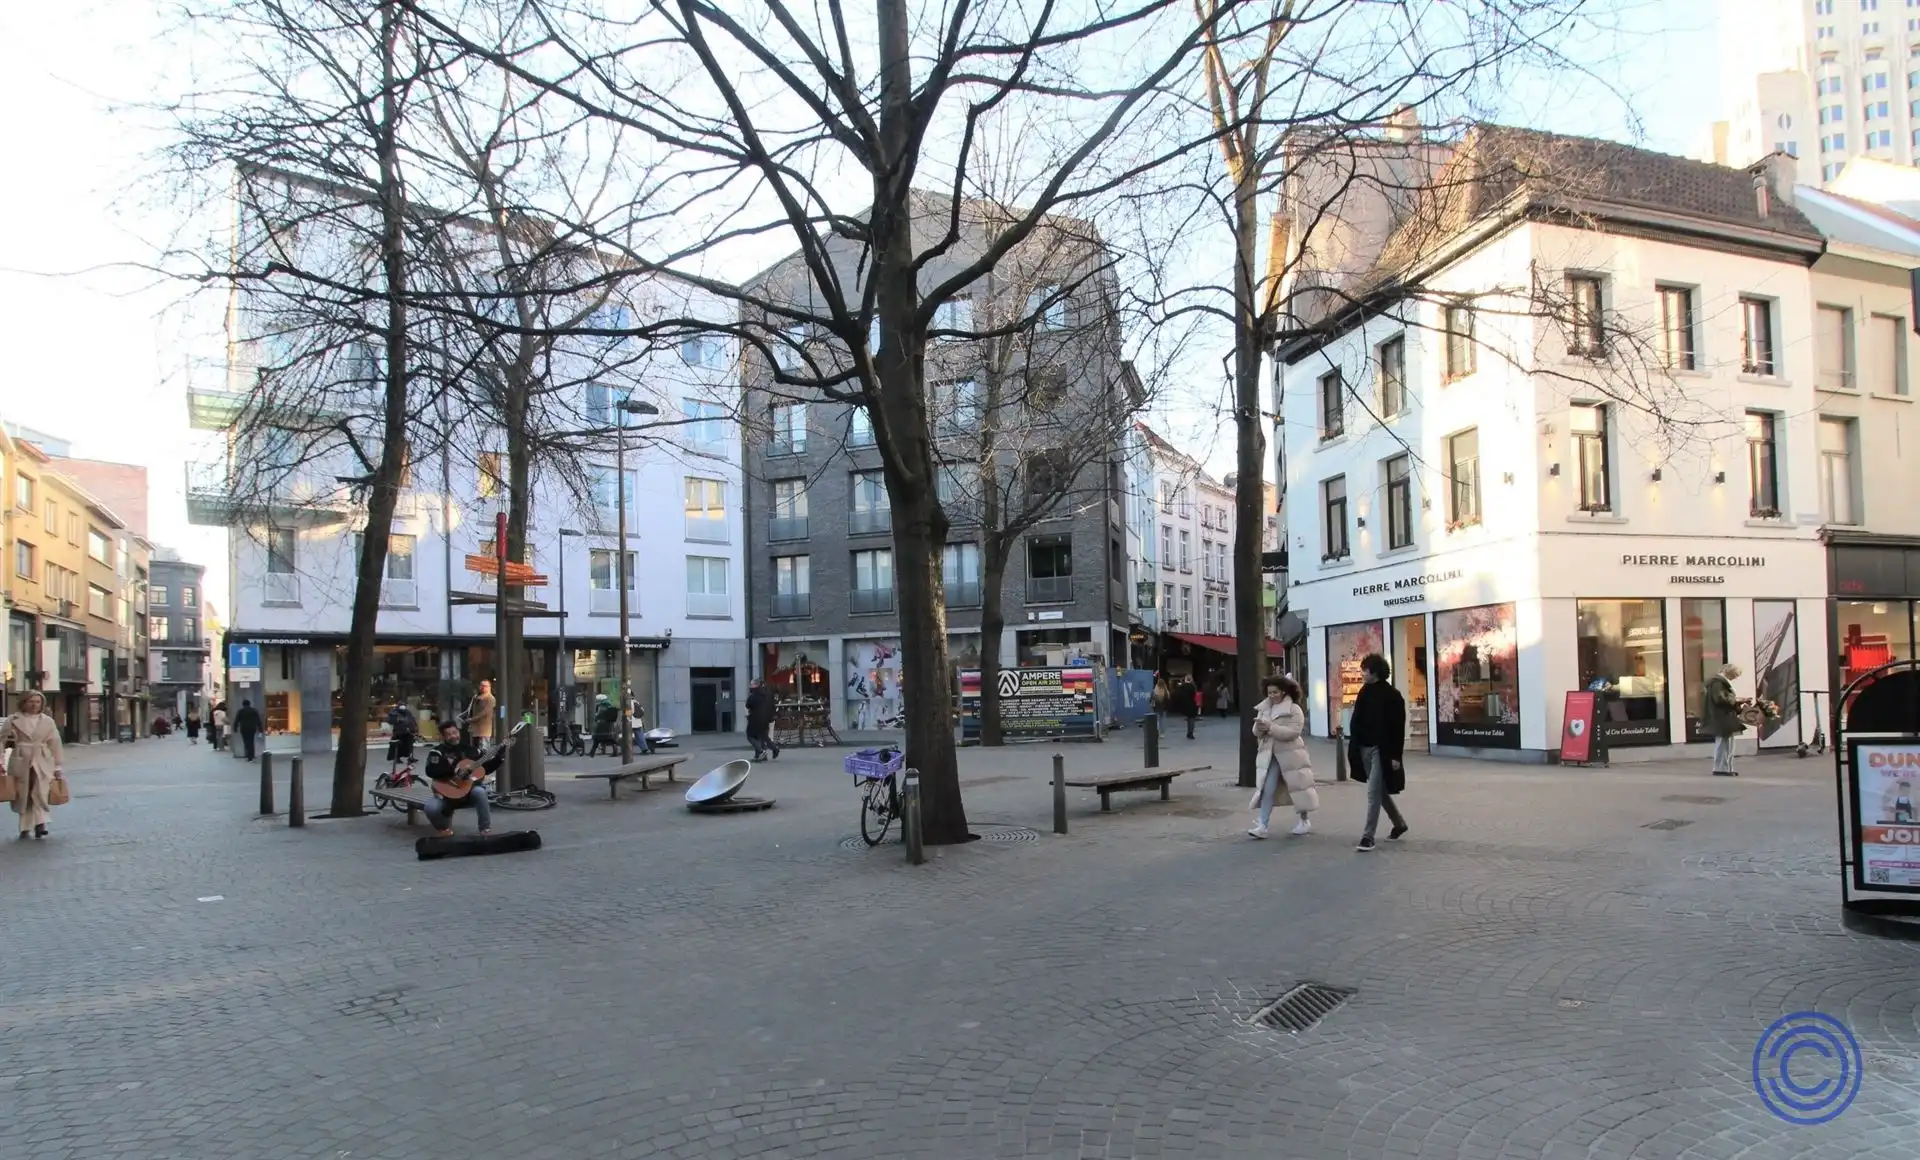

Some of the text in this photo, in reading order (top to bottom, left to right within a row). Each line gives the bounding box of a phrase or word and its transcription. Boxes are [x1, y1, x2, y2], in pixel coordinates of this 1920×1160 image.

[1623, 555, 1765, 566] PIERRE MARCOLINI
[1353, 568, 1463, 596] PIERRE MARCOLINI
[1670, 576, 1725, 584] BRUSSELS
[1383, 594, 1425, 607] BRUSSELS
[1021, 671, 1061, 680] AMPERE
